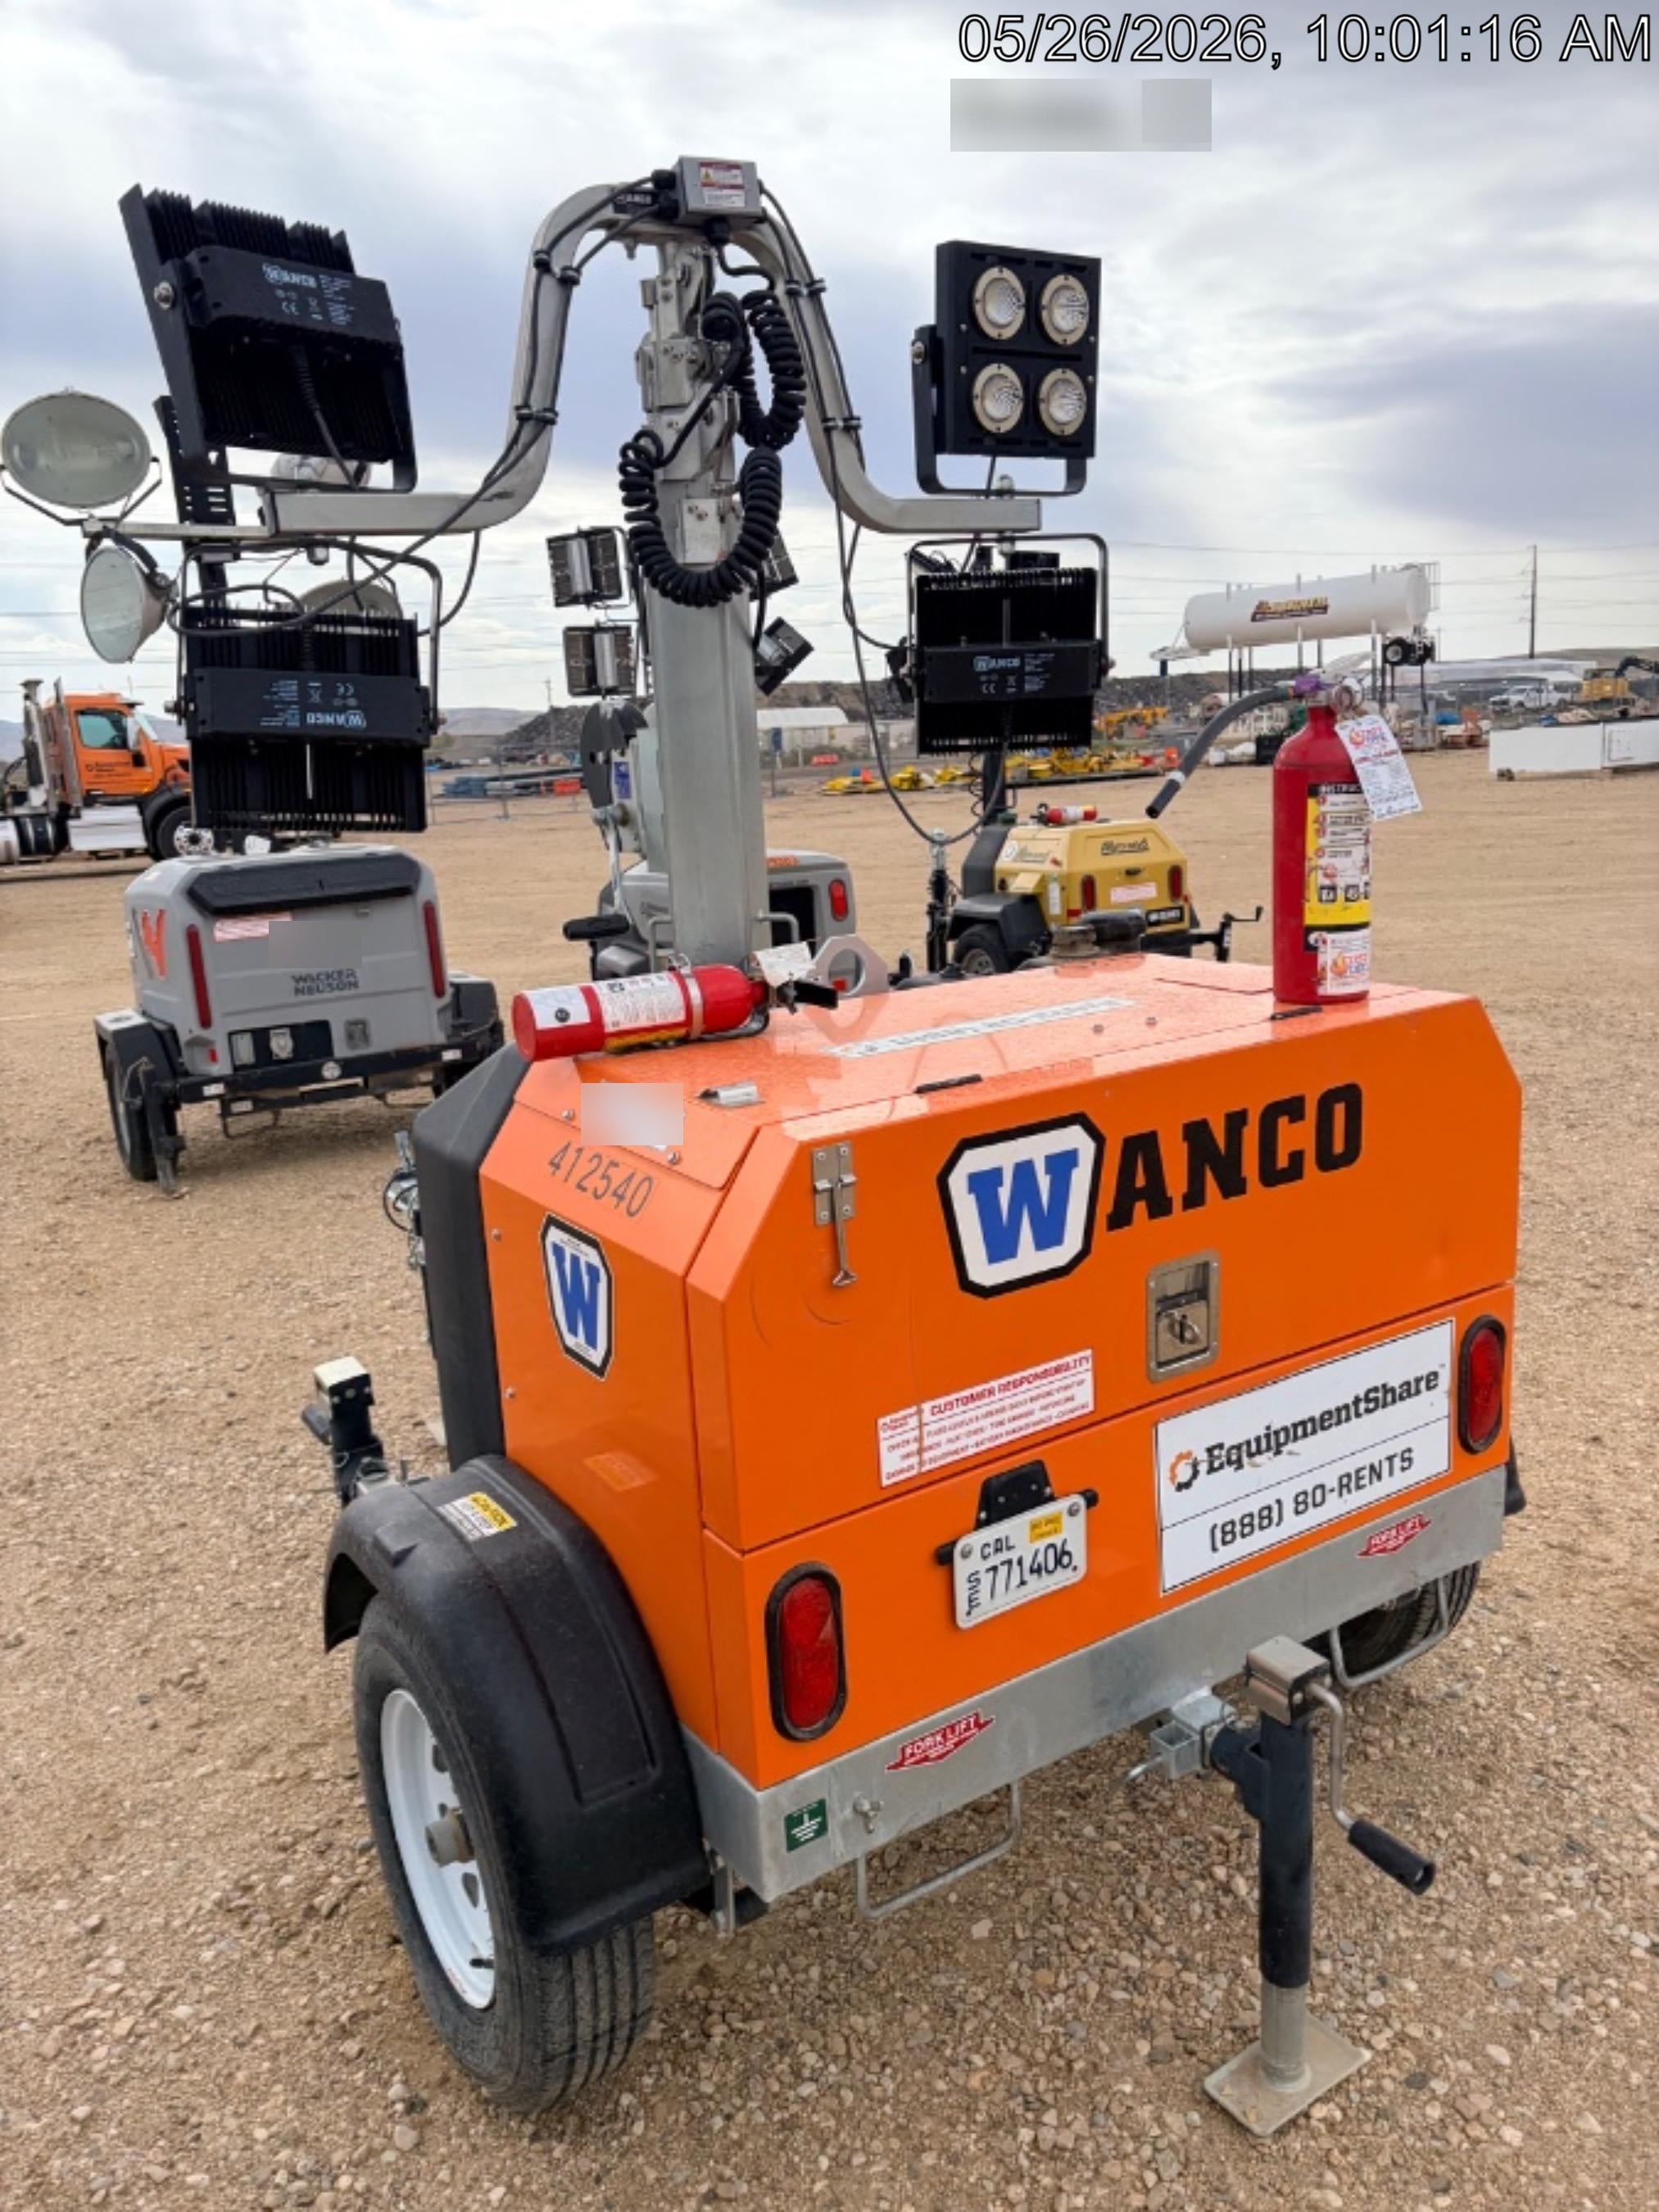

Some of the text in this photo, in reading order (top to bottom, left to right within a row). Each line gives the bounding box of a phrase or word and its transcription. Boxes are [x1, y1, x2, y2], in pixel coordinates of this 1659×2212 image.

[547, 1141, 654, 1217] 412540
[963, 1081, 1362, 1271] WANCO
[551, 1240, 601, 1352] W
[931, 1385, 996, 1416] CUSTOMER
[997, 1355, 1090, 1395] RESPONSIBILITY
[1206, 1370, 1439, 1475] EquipmentShare
[1210, 1447, 1414, 1552] (888) 80-RENTS
[981, 1535, 1015, 1561] CAL
[986, 1539, 1072, 1600] 771406
